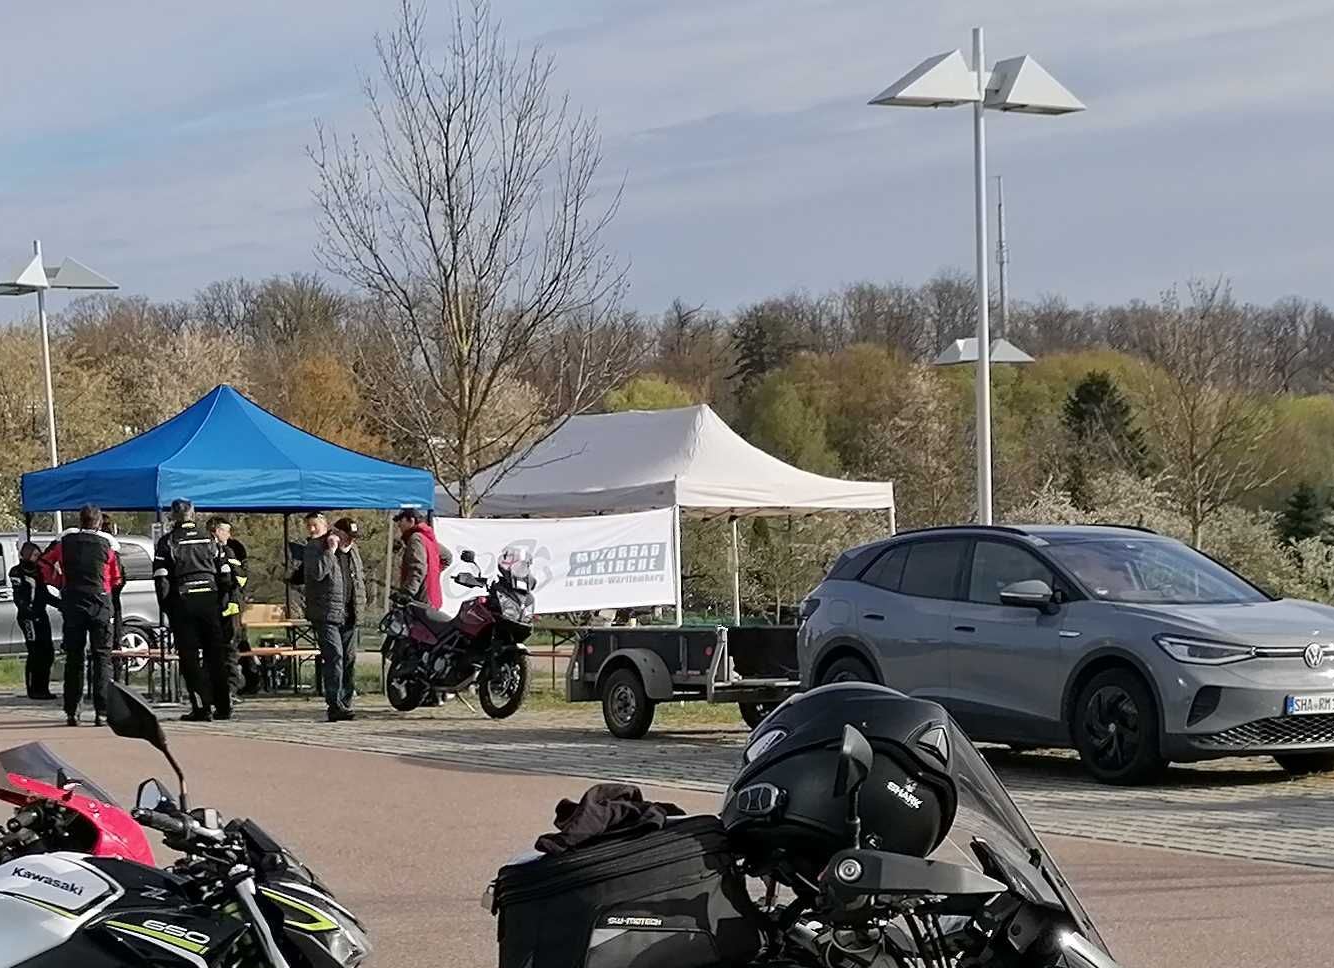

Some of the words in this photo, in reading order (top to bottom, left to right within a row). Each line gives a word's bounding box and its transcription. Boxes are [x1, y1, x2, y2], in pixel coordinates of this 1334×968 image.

[595, 558, 657, 574] KIRCHE
[887, 781, 924, 809] SHARK
[11, 866, 84, 896] Kawasaki
[142, 919, 211, 945] 650
